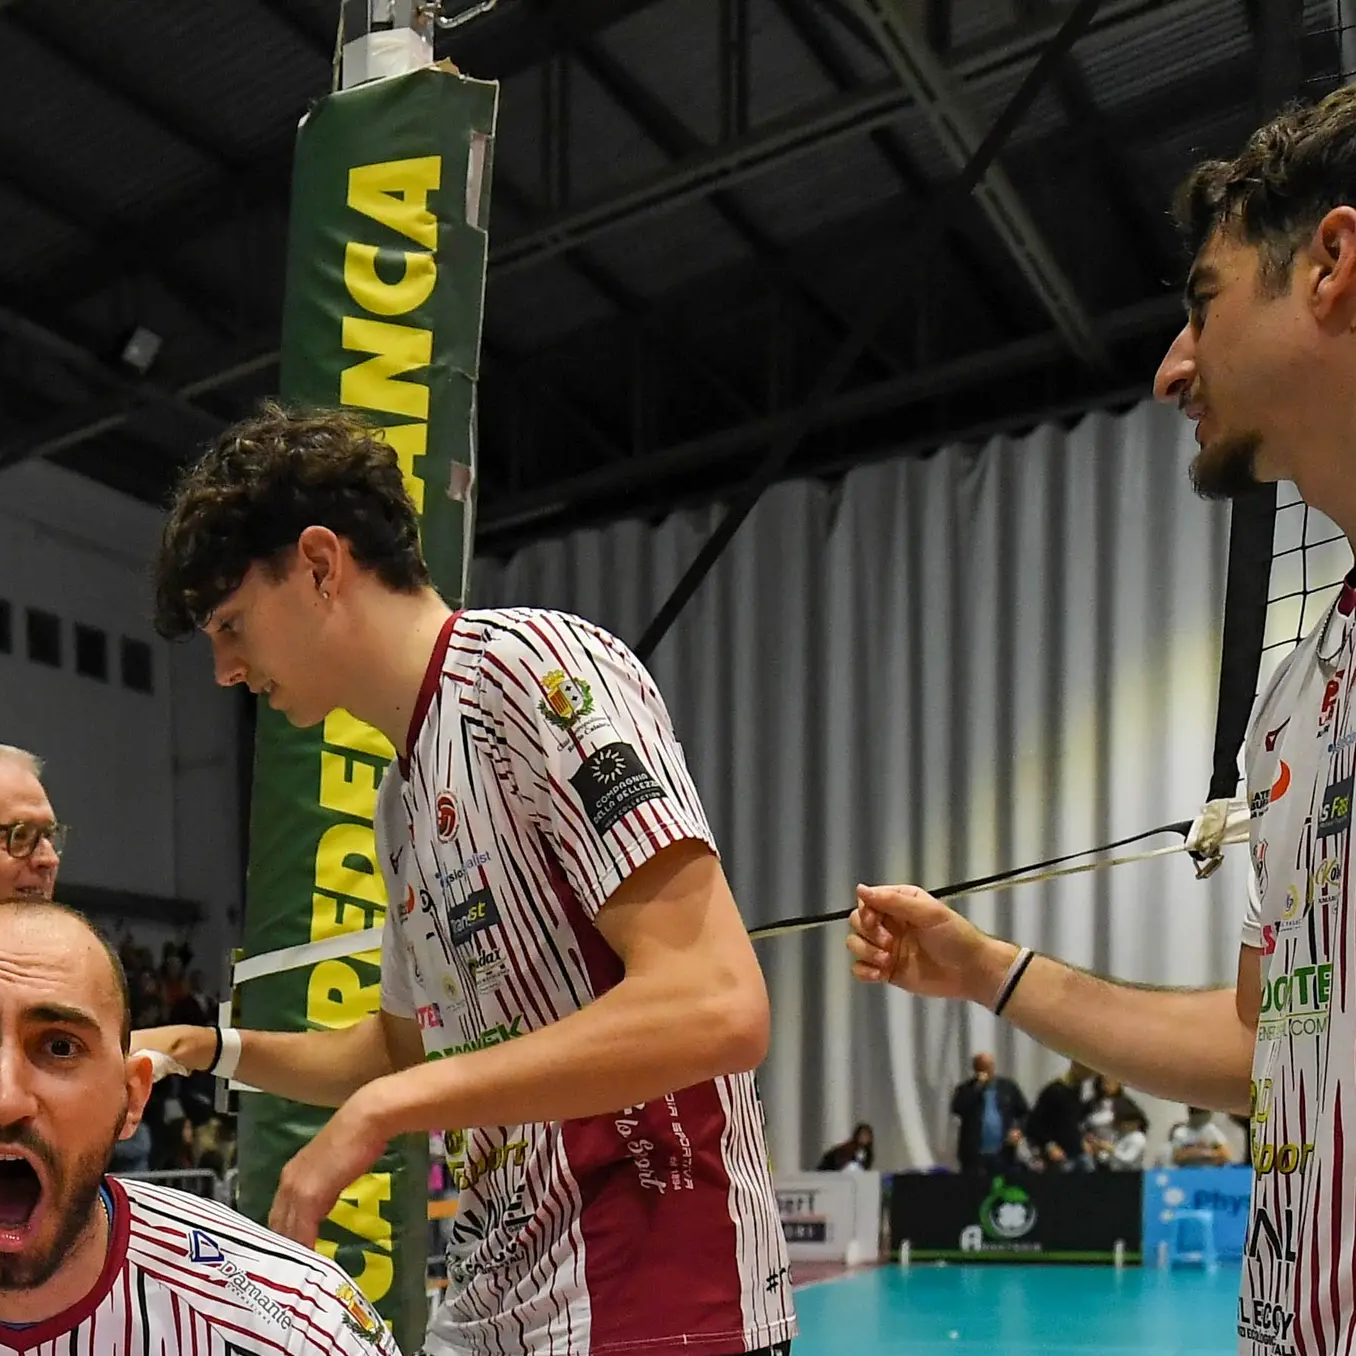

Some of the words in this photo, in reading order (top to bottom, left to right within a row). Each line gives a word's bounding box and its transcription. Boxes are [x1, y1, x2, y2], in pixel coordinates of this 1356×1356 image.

[340, 155, 441, 516] ANCA
[306, 706, 398, 1032] REDE
[595, 772, 649, 808] COMPAGNIA
